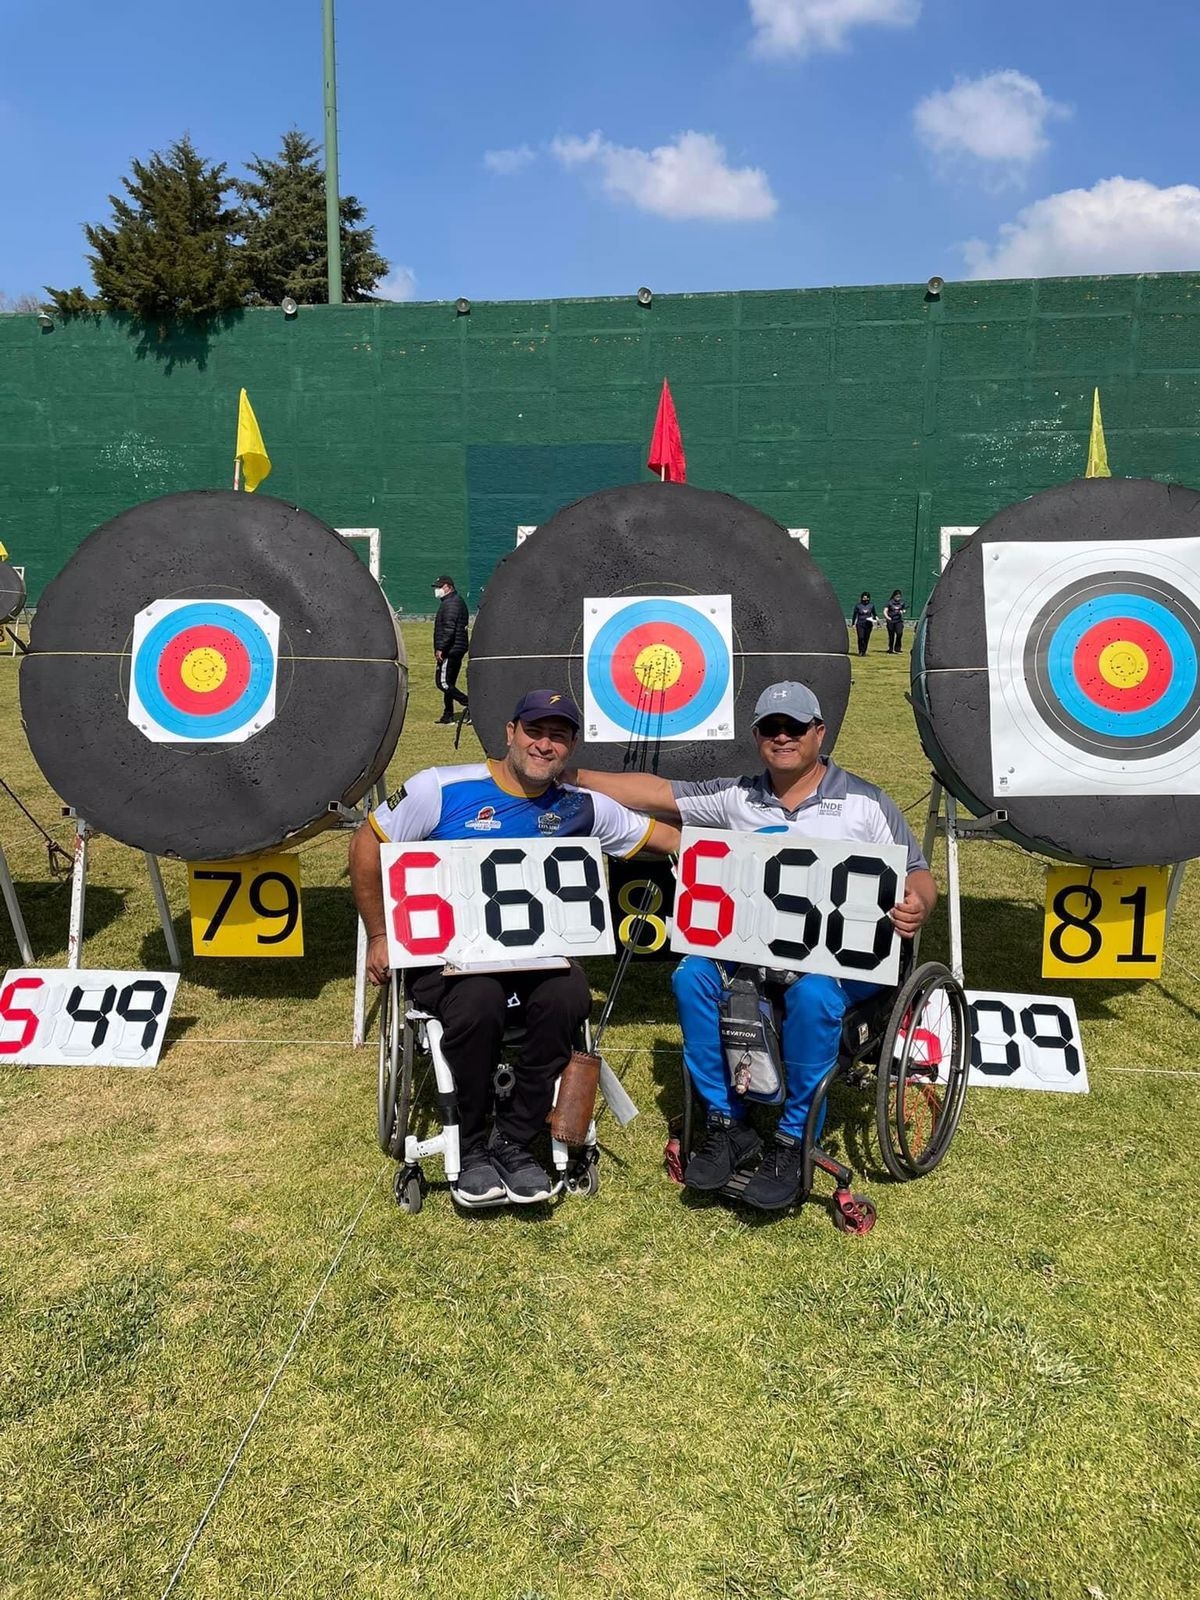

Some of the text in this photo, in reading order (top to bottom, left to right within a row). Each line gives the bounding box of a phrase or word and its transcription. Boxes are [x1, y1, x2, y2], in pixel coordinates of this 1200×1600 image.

[820, 801, 843, 811] INDE
[193, 870, 300, 944] 79
[618, 880, 667, 954] 8
[1049, 884, 1157, 964] 81
[722, 1029, 757, 1039] LEVATION
